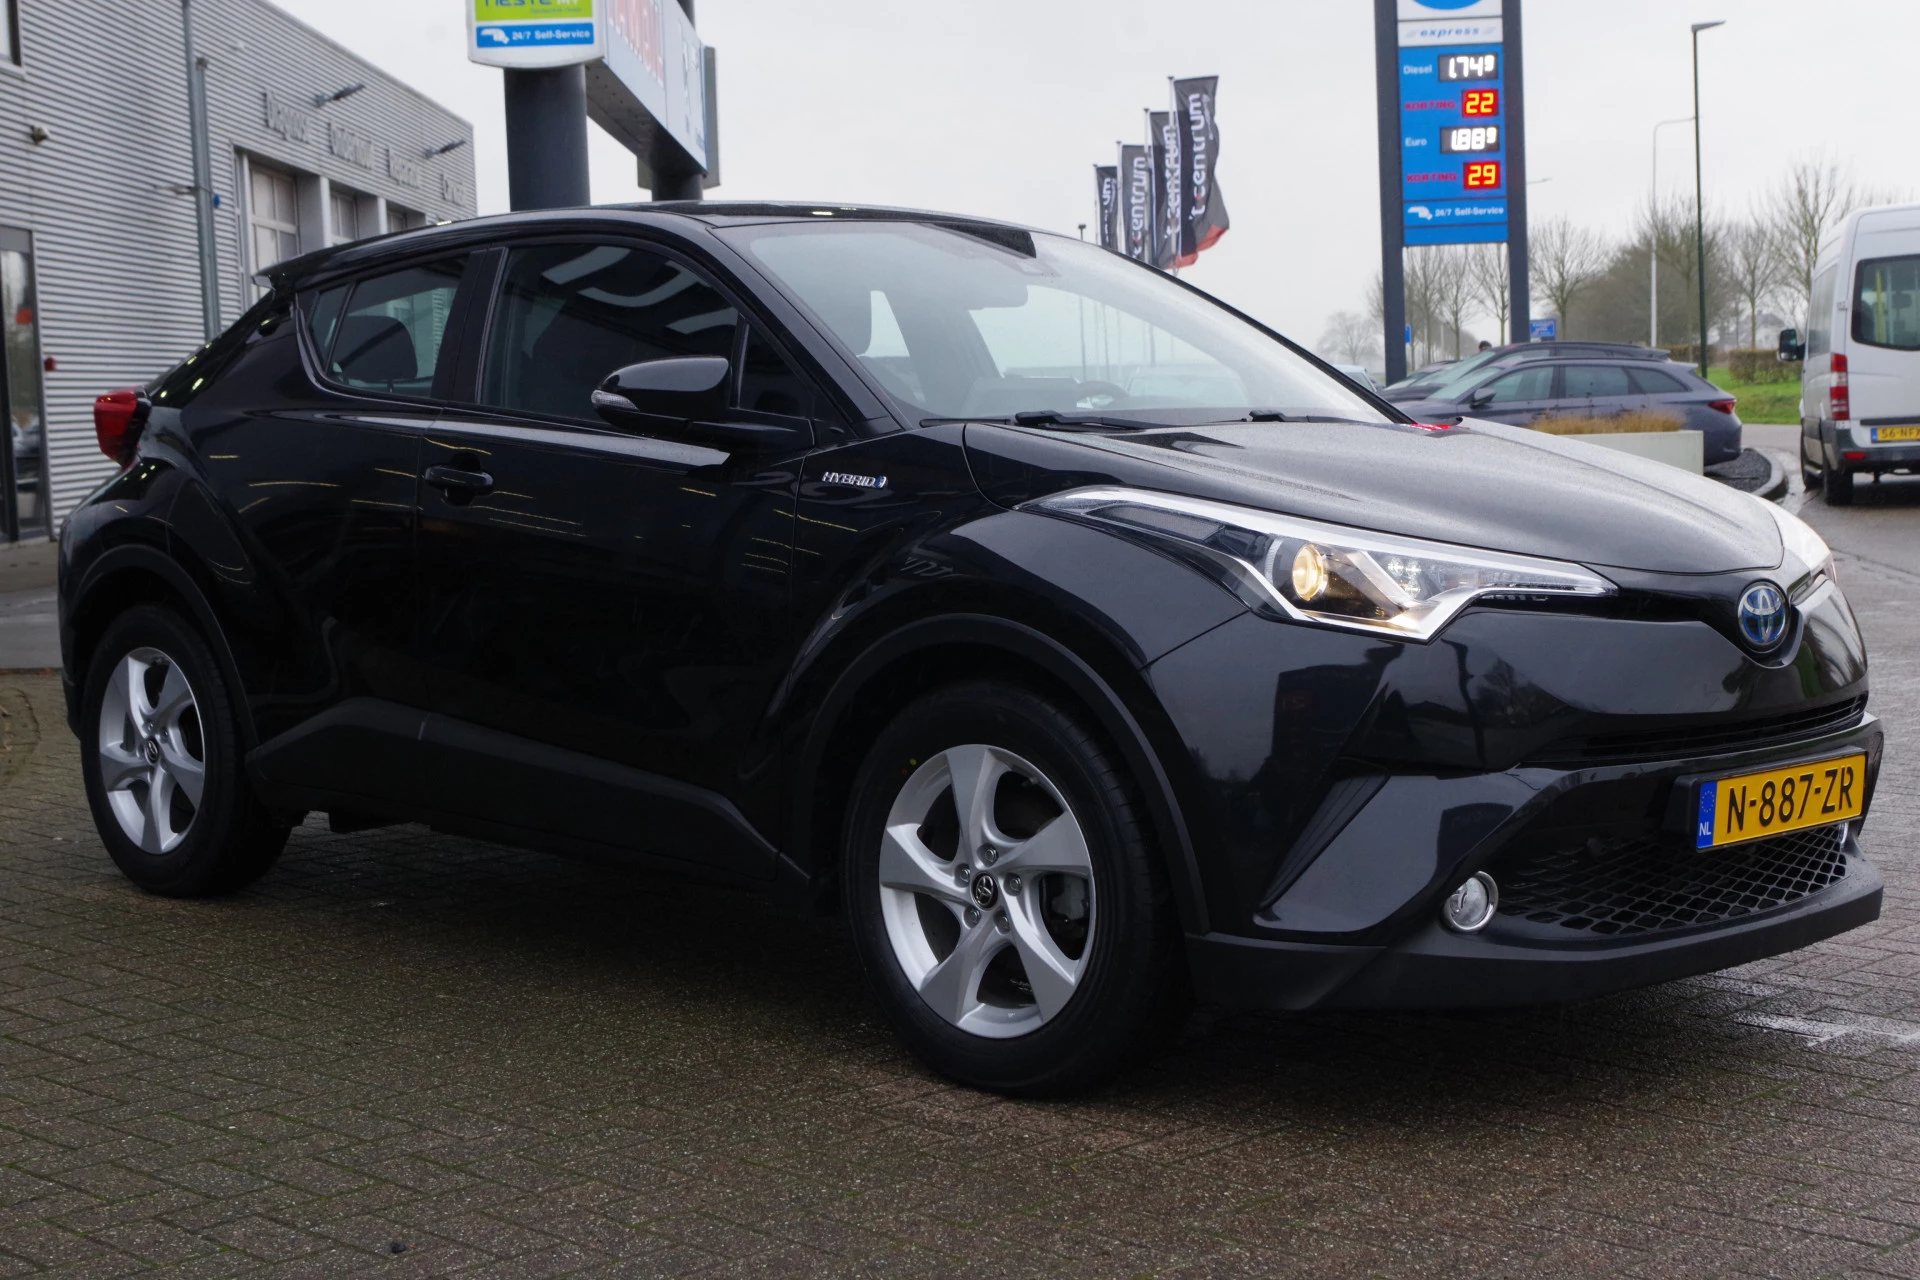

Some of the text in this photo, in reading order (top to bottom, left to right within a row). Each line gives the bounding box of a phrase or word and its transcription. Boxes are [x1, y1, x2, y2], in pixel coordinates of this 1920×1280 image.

[511, 29, 590, 40] 24/7 Self-Service
[1420, 26, 1480, 38] express
[1403, 65, 1433, 75] Diesel
[1405, 93, 1494, 114] KORTING 22
[1188, 93, 1206, 200] centrum
[1405, 137, 1427, 147] Euro
[1407, 165, 1496, 185] KORTING 29
[1131, 156, 1146, 243] centrum
[1435, 206, 1504, 217] 24/7 Self-Service
[821, 471, 876, 487] HYBRID
[1727, 766, 1854, 834] N-887-ZR
[1699, 822, 1711, 836] NL
